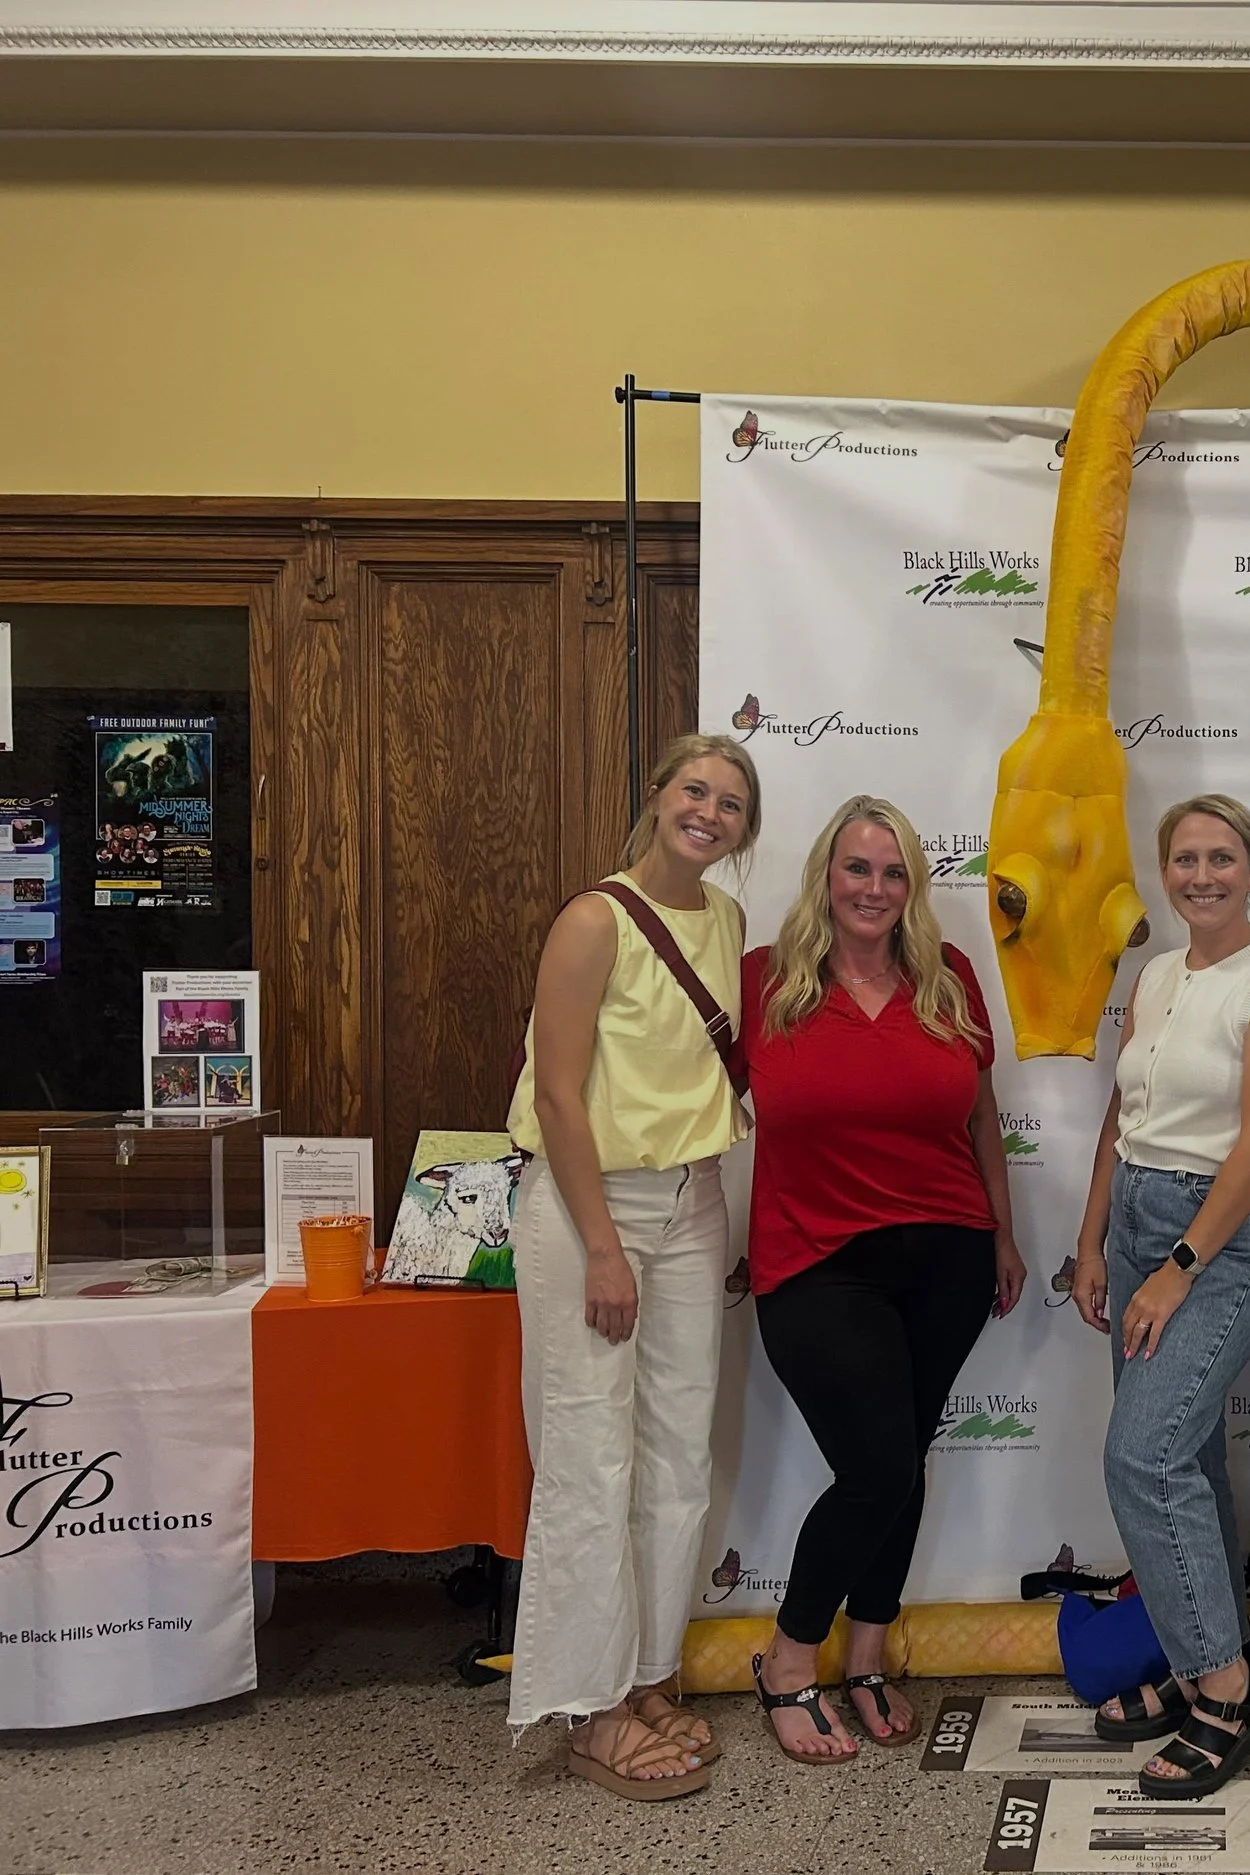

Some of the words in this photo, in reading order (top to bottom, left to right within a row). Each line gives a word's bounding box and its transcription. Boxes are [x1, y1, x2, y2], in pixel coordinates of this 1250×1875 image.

[726, 430, 804, 462] Flutter
[791, 431, 918, 463] Productions
[903, 551, 945, 570] Black
[948, 551, 986, 570] Hills
[989, 551, 1039, 570] Works
[100, 718, 118, 728] FREE
[121, 718, 157, 728] OUTDOOR
[159, 718, 187, 728] FAMILY
[795, 711, 919, 746] Productions
[1123, 714, 1238, 750] Productions
[952, 834, 989, 853] Hills
[1103, 1005, 1128, 1016] tter
[945, 1395, 982, 1413] Hills
[987, 1394, 1037, 1413] Works
[0, 1631, 17, 1645] he
[21, 1630, 57, 1644] Black
[60, 1627, 93, 1642] Hills
[96, 1618, 144, 1637] Works
[147, 1616, 193, 1632] Family
[932, 1710, 974, 1754] 1959
[997, 1796, 1039, 1851] 1957
